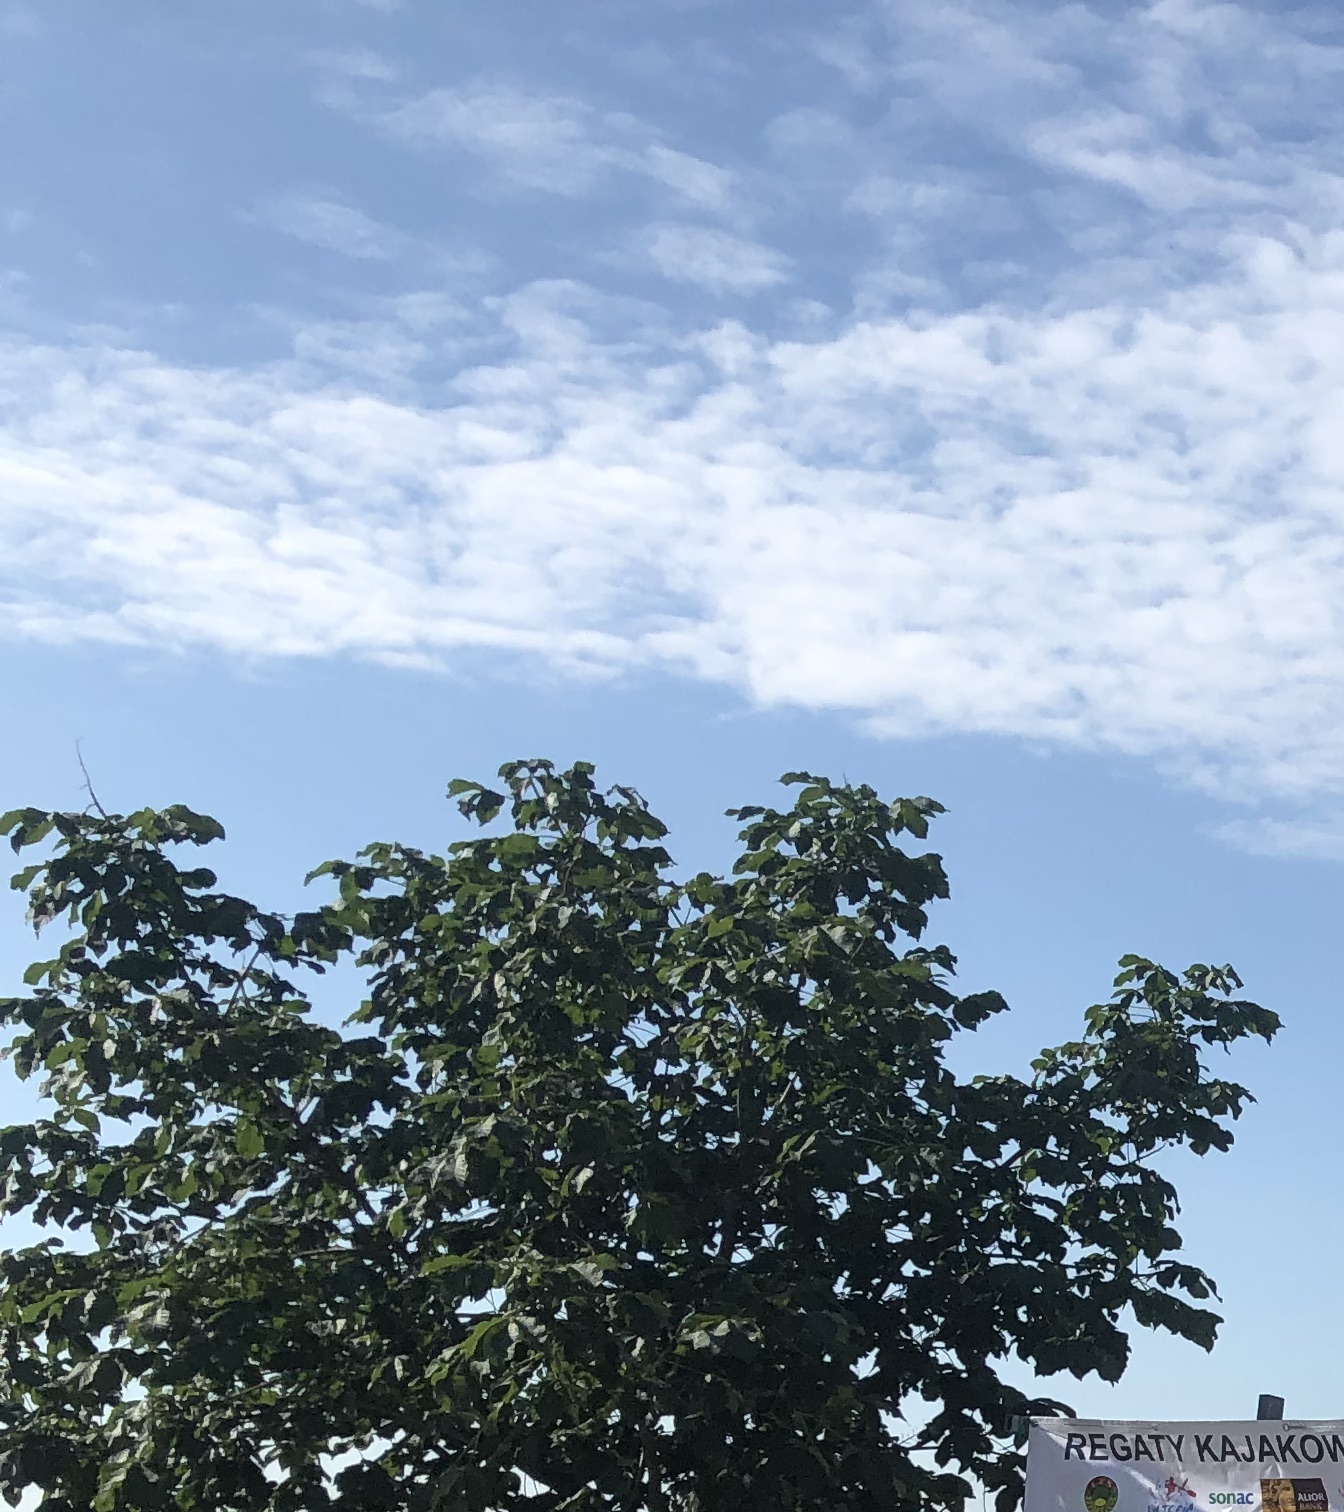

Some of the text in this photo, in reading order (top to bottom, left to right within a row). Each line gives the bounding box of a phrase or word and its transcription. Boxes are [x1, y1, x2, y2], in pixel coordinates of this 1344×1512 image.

[1064, 1433, 1184, 1461] REGATY
[1209, 1492, 1254, 1504] sonac
[1298, 1492, 1325, 1501] ALIOR
